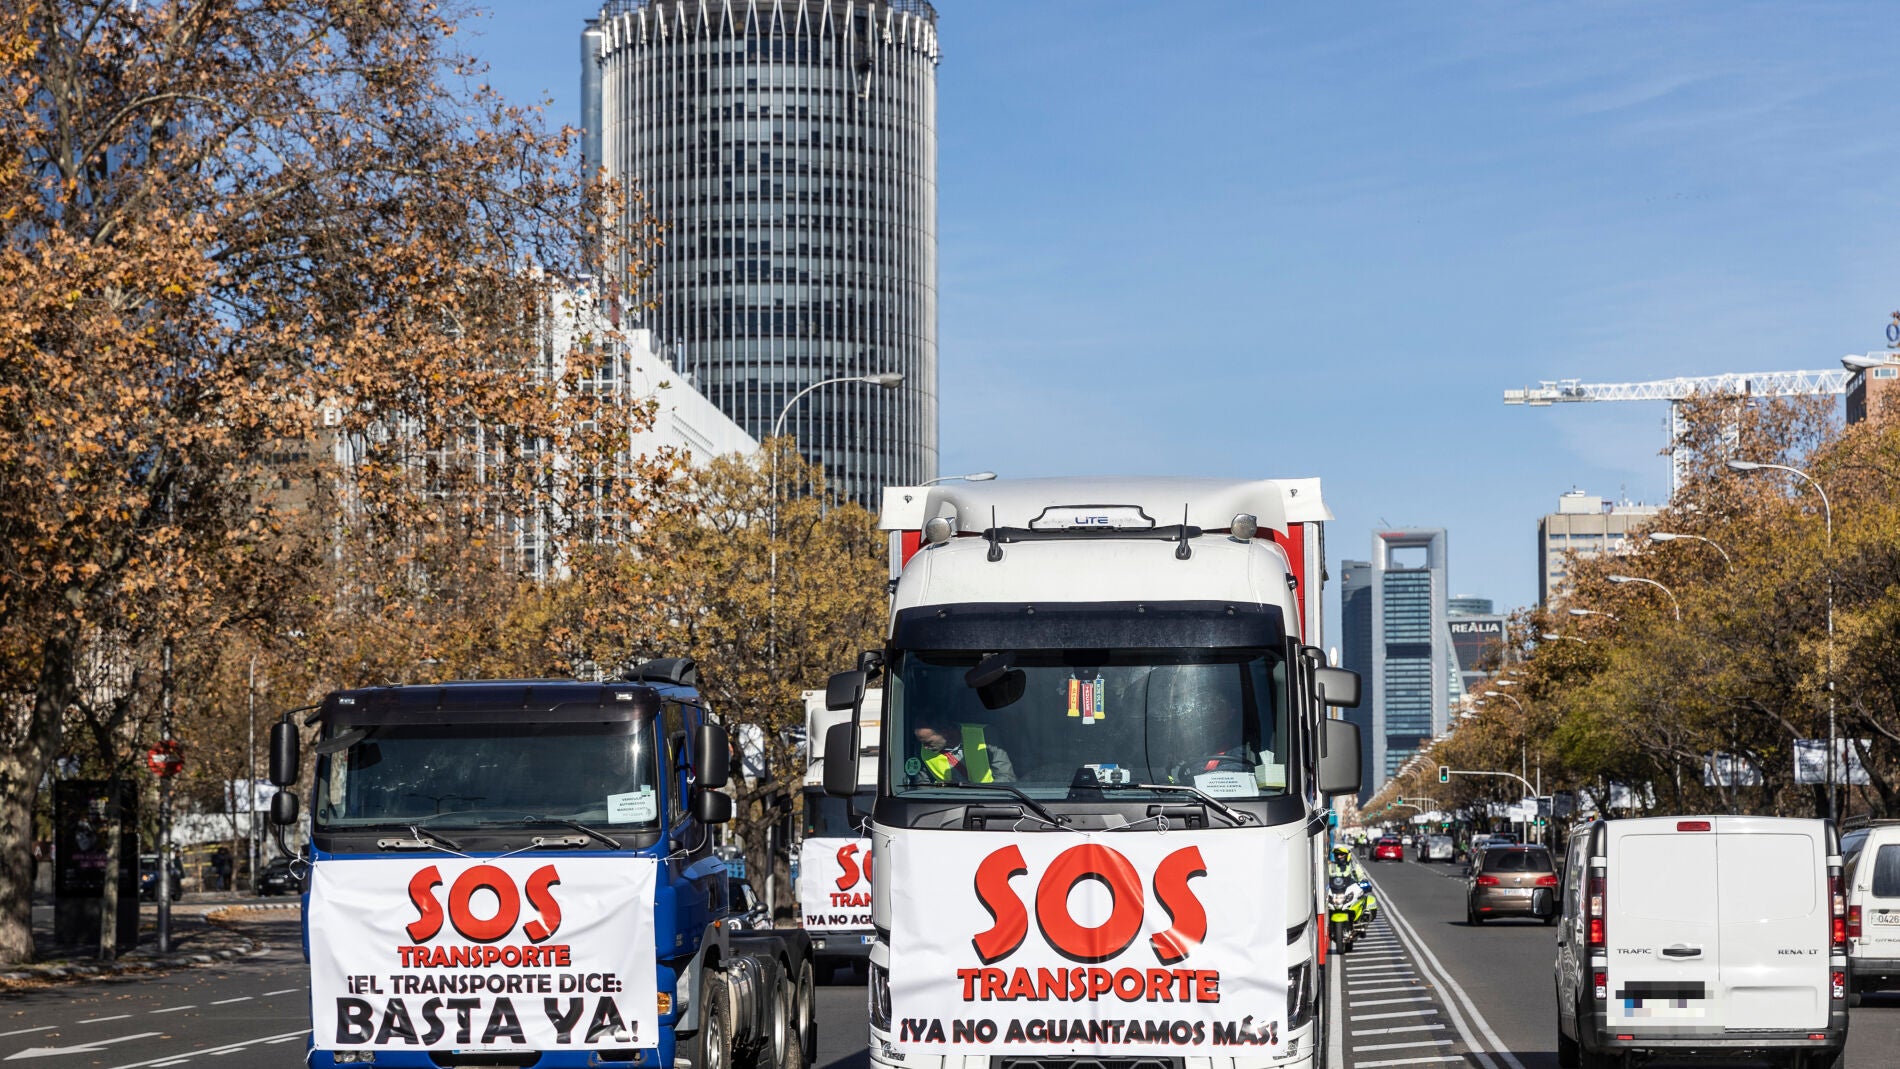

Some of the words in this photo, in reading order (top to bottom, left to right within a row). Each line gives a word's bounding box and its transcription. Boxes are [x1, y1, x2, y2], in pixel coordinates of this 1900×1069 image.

[1075, 516, 1109, 525] LITE
[836, 843, 871, 892] S
[405, 864, 562, 944] SOS
[828, 914, 848, 925] NO
[971, 844, 1208, 966] SOS
[1878, 915, 1900, 924] 0426
[397, 944, 572, 968] TRANSPORTE
[390, 973, 552, 994] TRANSPORTE
[559, 973, 622, 993] DICE:
[957, 967, 1221, 1003] TRANSPORTE
[335, 996, 526, 1046] BASTA
[543, 996, 639, 1045] YA!
[952, 1018, 998, 1044] NO
[1003, 1018, 1206, 1046] AGUANTAMOS
[1211, 1014, 1279, 1047] MÁS!
